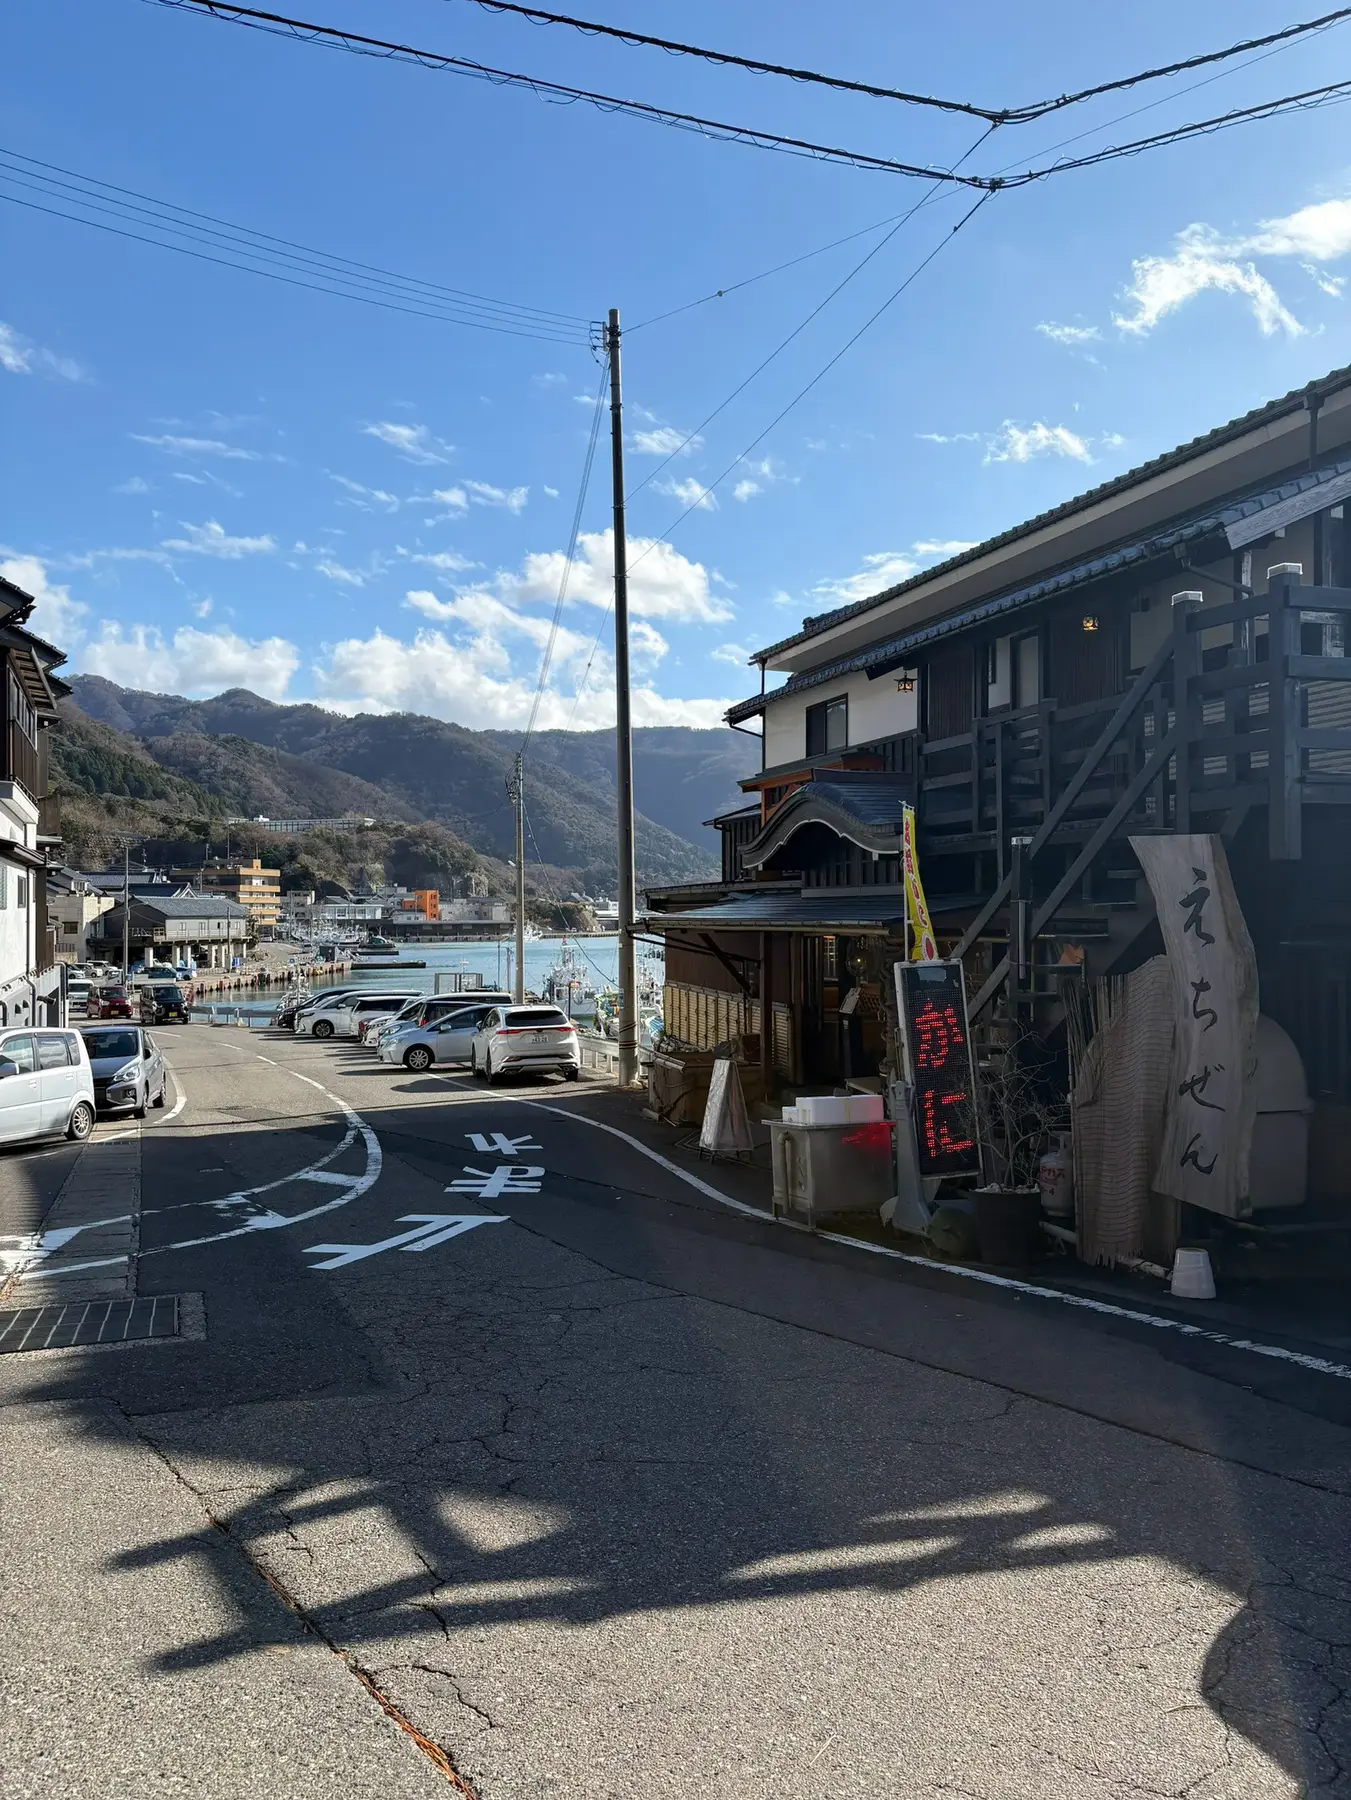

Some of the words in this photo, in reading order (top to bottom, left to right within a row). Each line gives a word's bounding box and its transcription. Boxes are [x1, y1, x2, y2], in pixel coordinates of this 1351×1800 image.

[915, 998, 974, 1157] かに
[1179, 867, 1226, 1175] えちぜん
[302, 1132, 545, 1270] 止まれ
